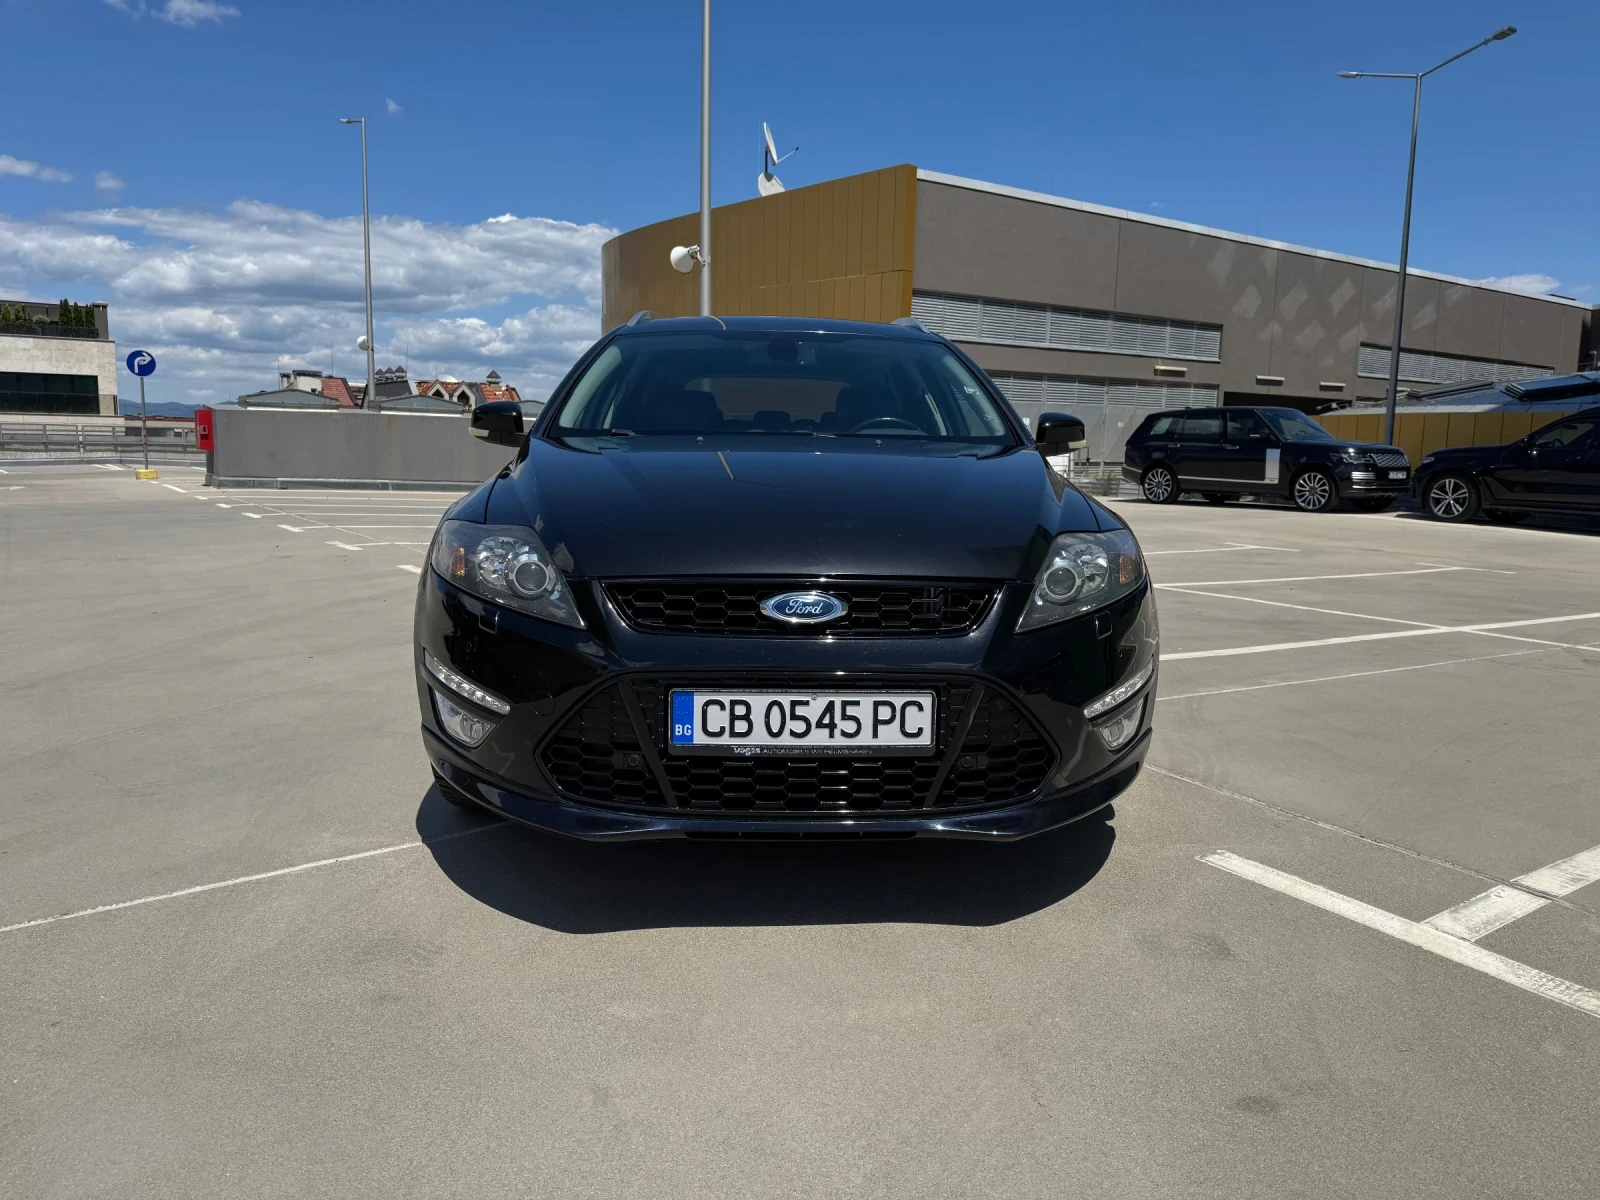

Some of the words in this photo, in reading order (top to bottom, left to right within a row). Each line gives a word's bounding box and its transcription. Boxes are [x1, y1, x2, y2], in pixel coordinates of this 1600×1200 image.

[785, 598, 823, 614] Ford
[701, 698, 754, 738] CB
[764, 699, 863, 738] 0545
[872, 699, 925, 739] PC
[674, 724, 692, 736] BG
